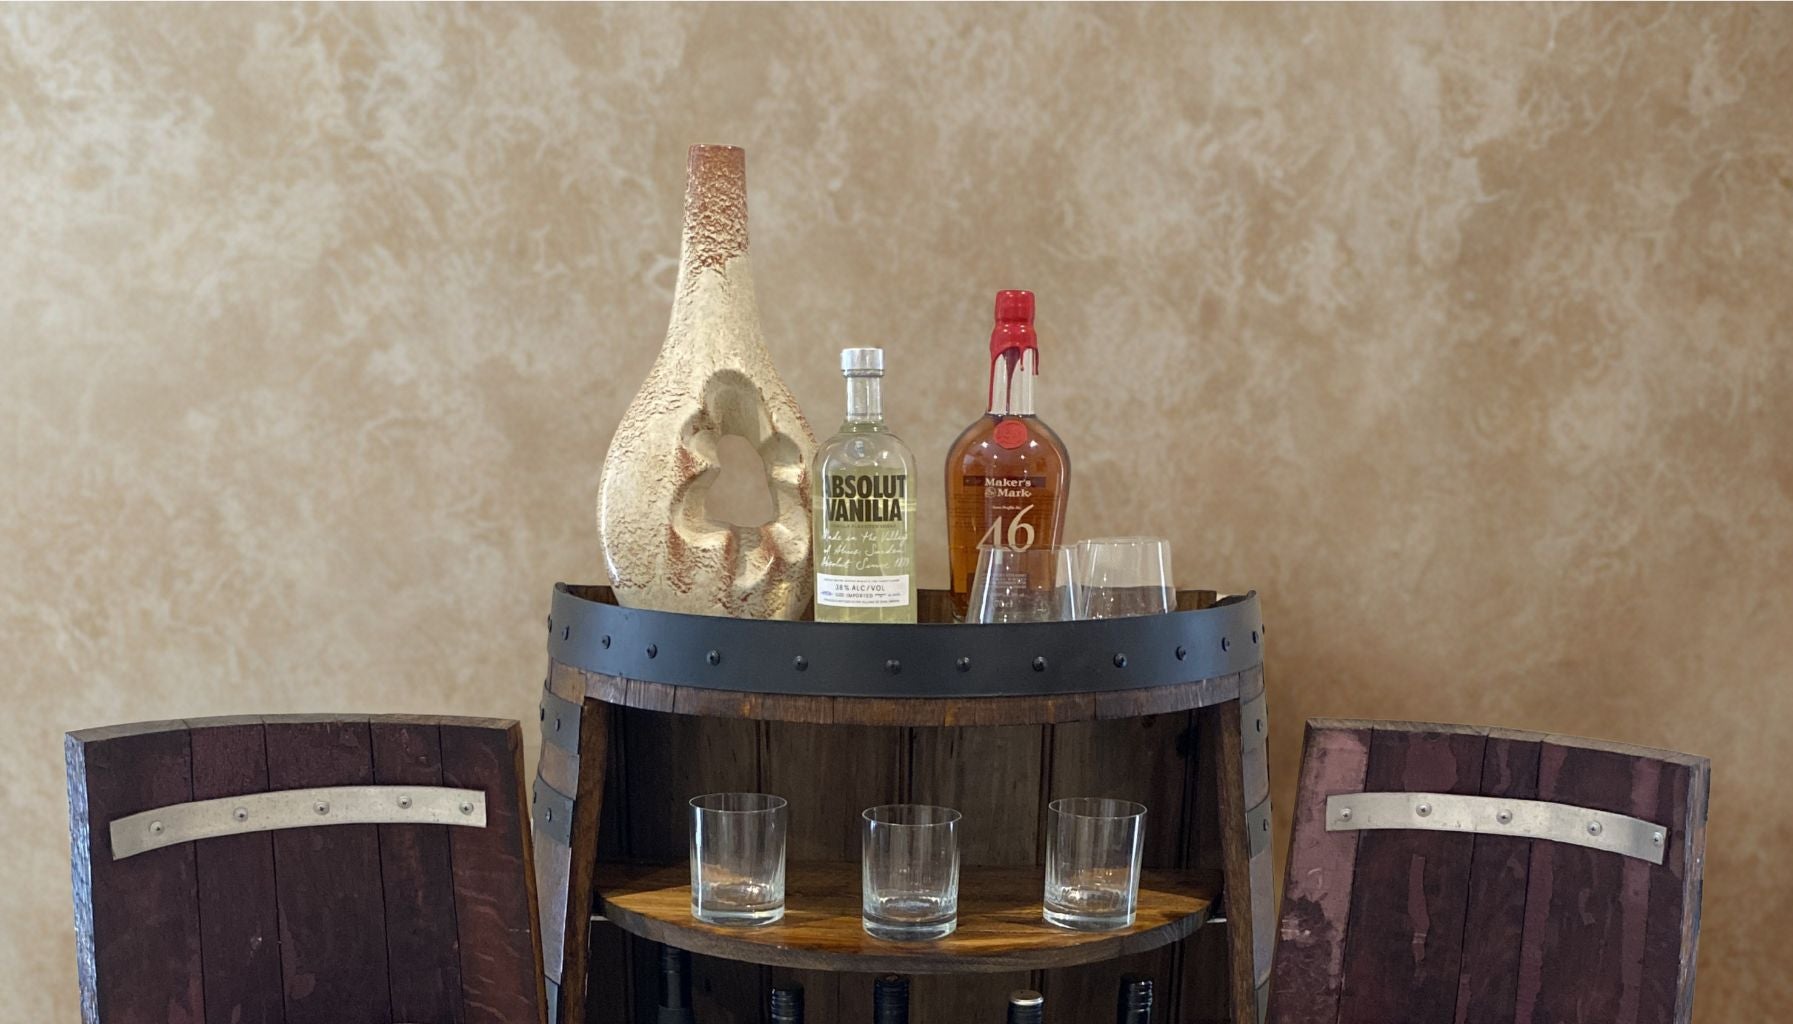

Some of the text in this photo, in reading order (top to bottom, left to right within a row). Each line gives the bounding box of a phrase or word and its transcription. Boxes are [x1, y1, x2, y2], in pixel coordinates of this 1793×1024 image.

[823, 475, 907, 498] ABSOLUT
[985, 477, 1032, 487] Maker's
[826, 499, 903, 522] VANILIA
[976, 504, 1035, 552] 46
[851, 583, 886, 592] ALC/VOL
